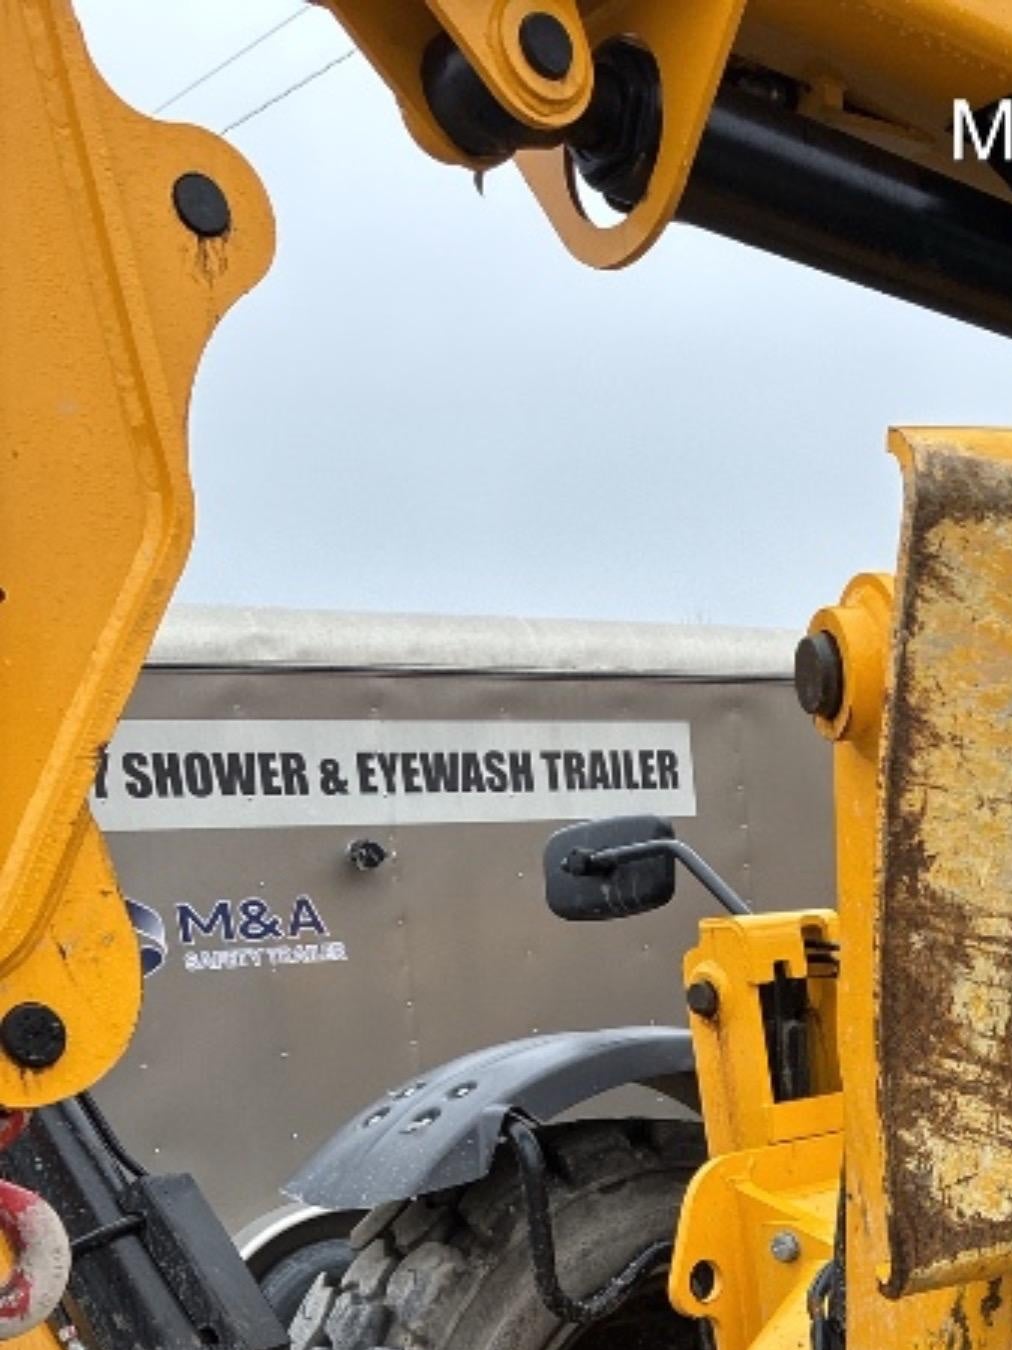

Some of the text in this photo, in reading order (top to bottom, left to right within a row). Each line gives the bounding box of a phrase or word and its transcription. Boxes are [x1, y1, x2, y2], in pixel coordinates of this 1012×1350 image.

[121, 750, 311, 799] SHOWER
[318, 757, 351, 797] &
[355, 749, 536, 794] EYEWASH
[539, 749, 681, 791] TRAILER
[174, 894, 332, 946] M&A
